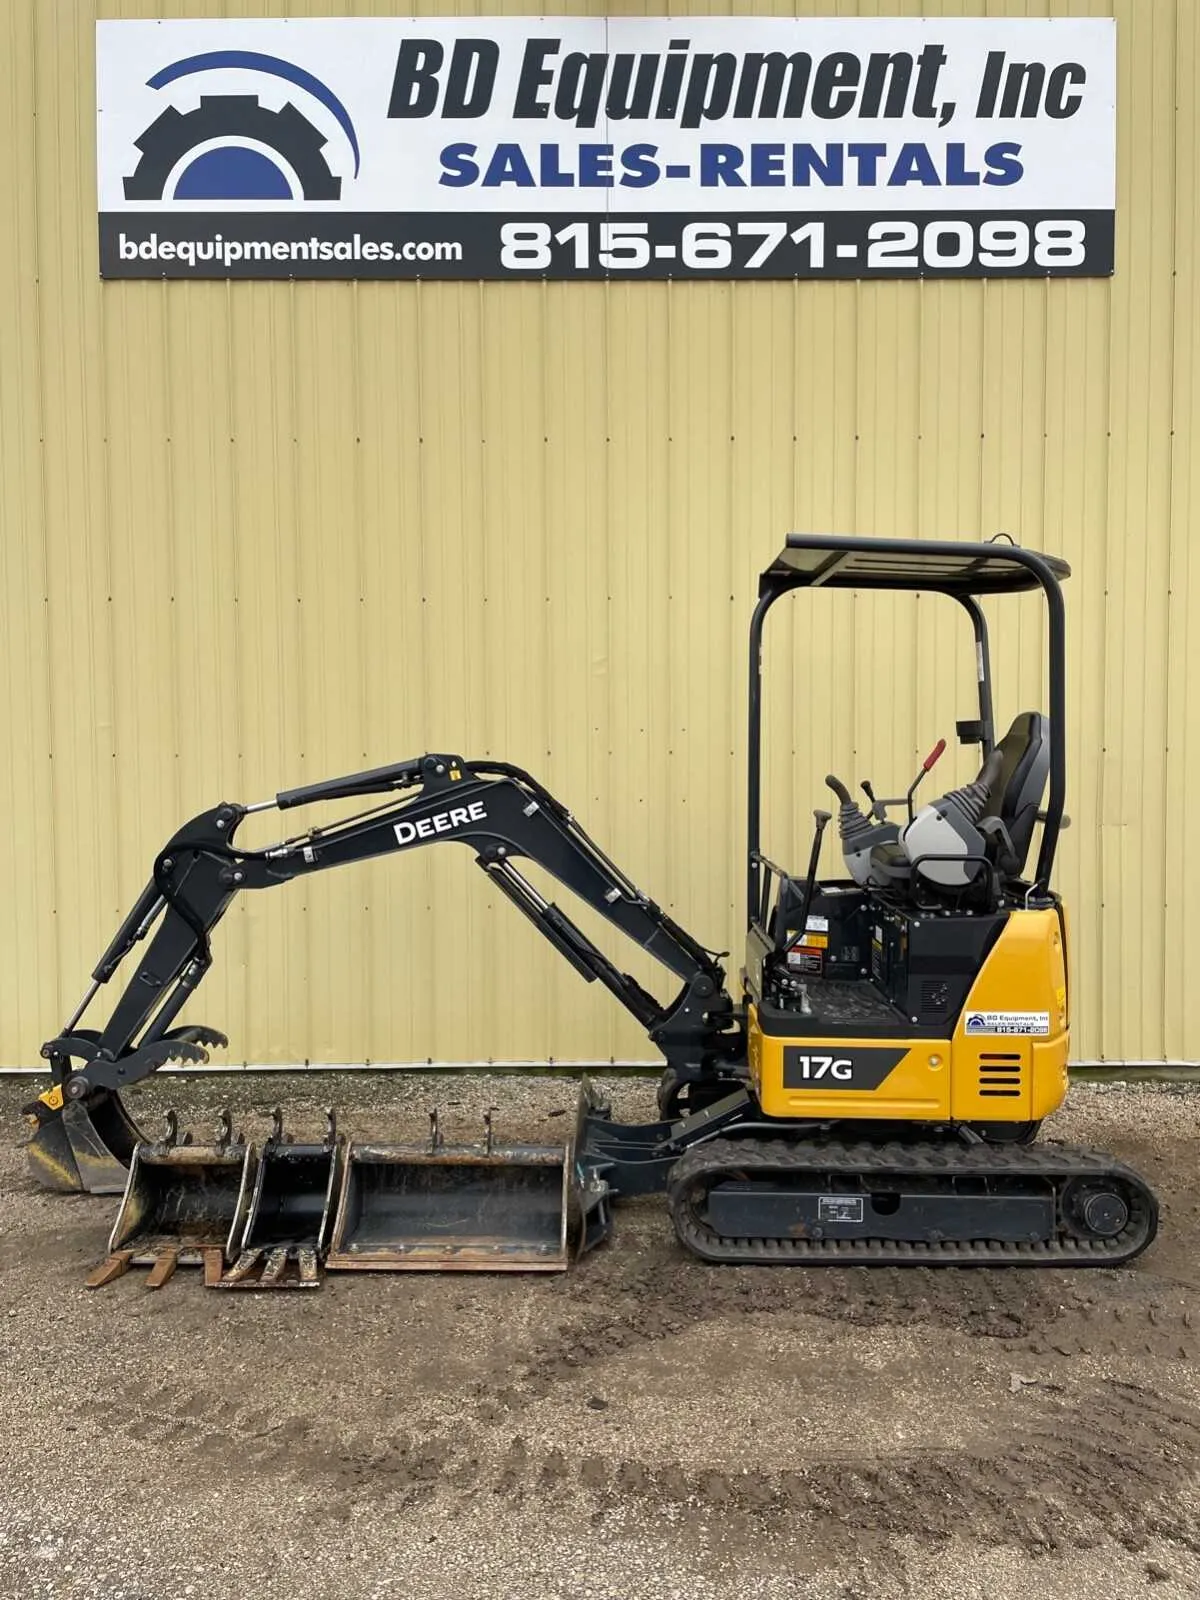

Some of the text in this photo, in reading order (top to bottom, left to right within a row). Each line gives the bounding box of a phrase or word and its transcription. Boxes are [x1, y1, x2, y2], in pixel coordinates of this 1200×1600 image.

[387, 39, 1087, 128] BD Equipment, Inc
[438, 141, 1024, 187] SALES-RENTALS
[118, 234, 463, 266] bdequipmentsales.com
[500, 219, 1086, 270] 815-671-2098
[393, 801, 488, 845] DEERE
[799, 1056, 852, 1080] 17G
